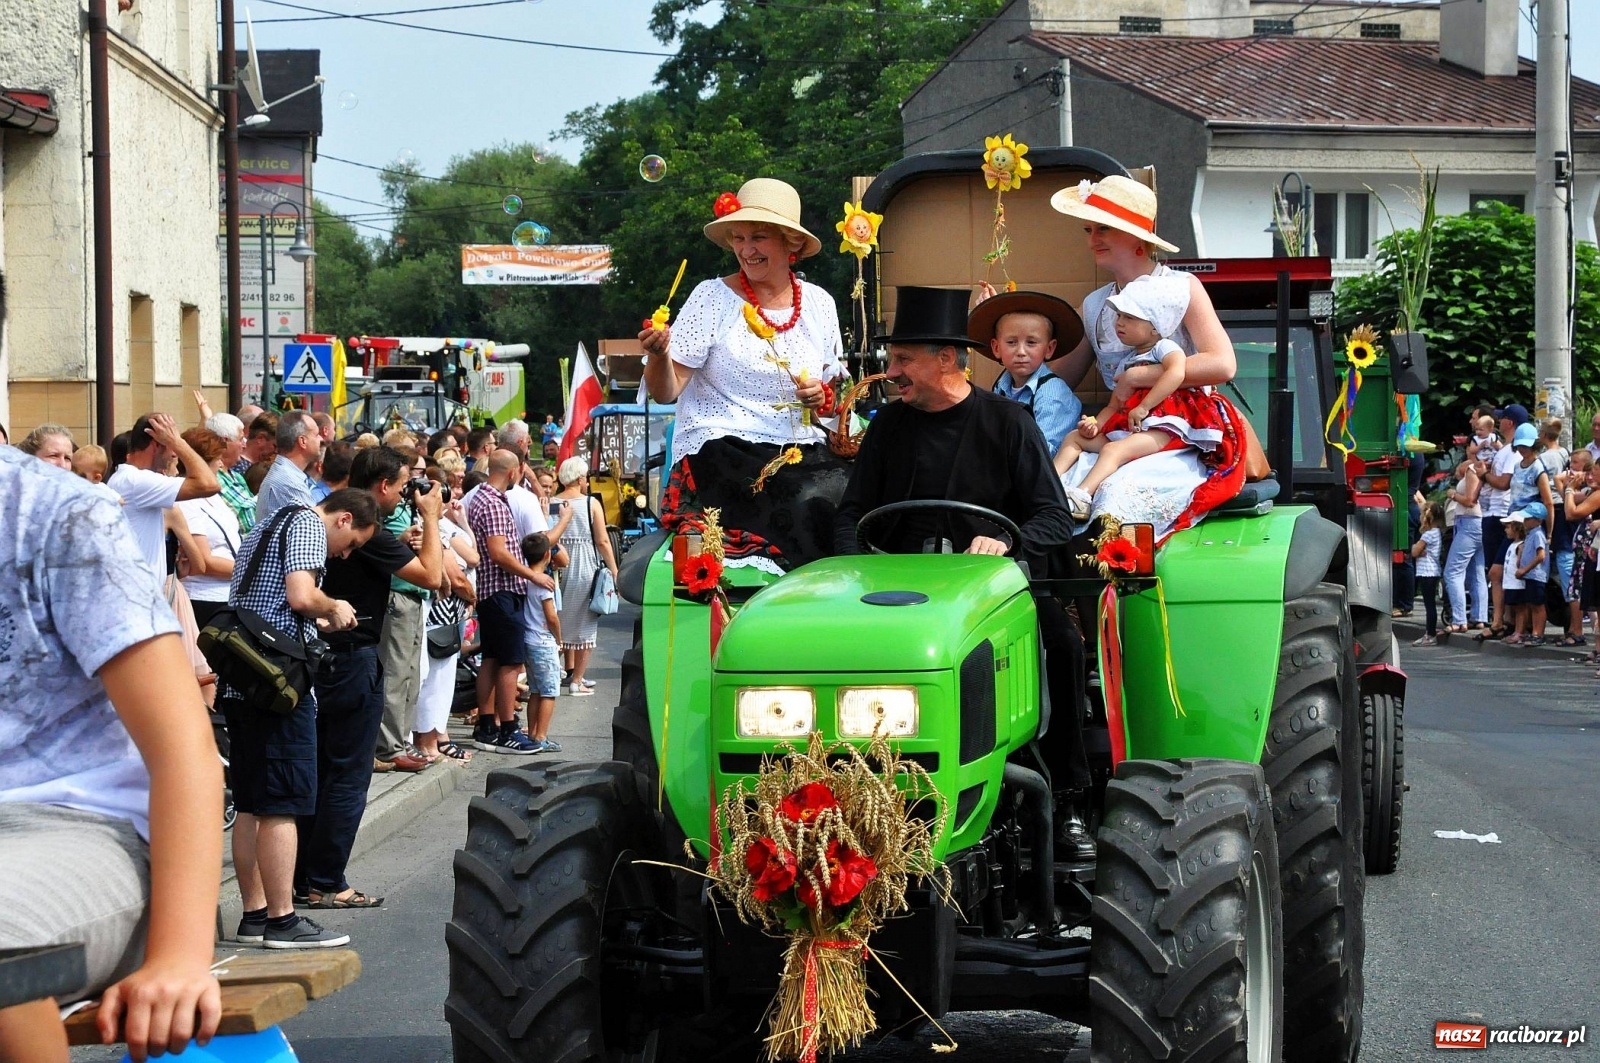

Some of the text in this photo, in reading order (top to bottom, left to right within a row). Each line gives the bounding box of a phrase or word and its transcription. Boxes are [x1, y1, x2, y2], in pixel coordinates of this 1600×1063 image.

[237, 157, 290, 169] ervice
[269, 293, 280, 302] 82
[283, 293, 295, 302] 96
